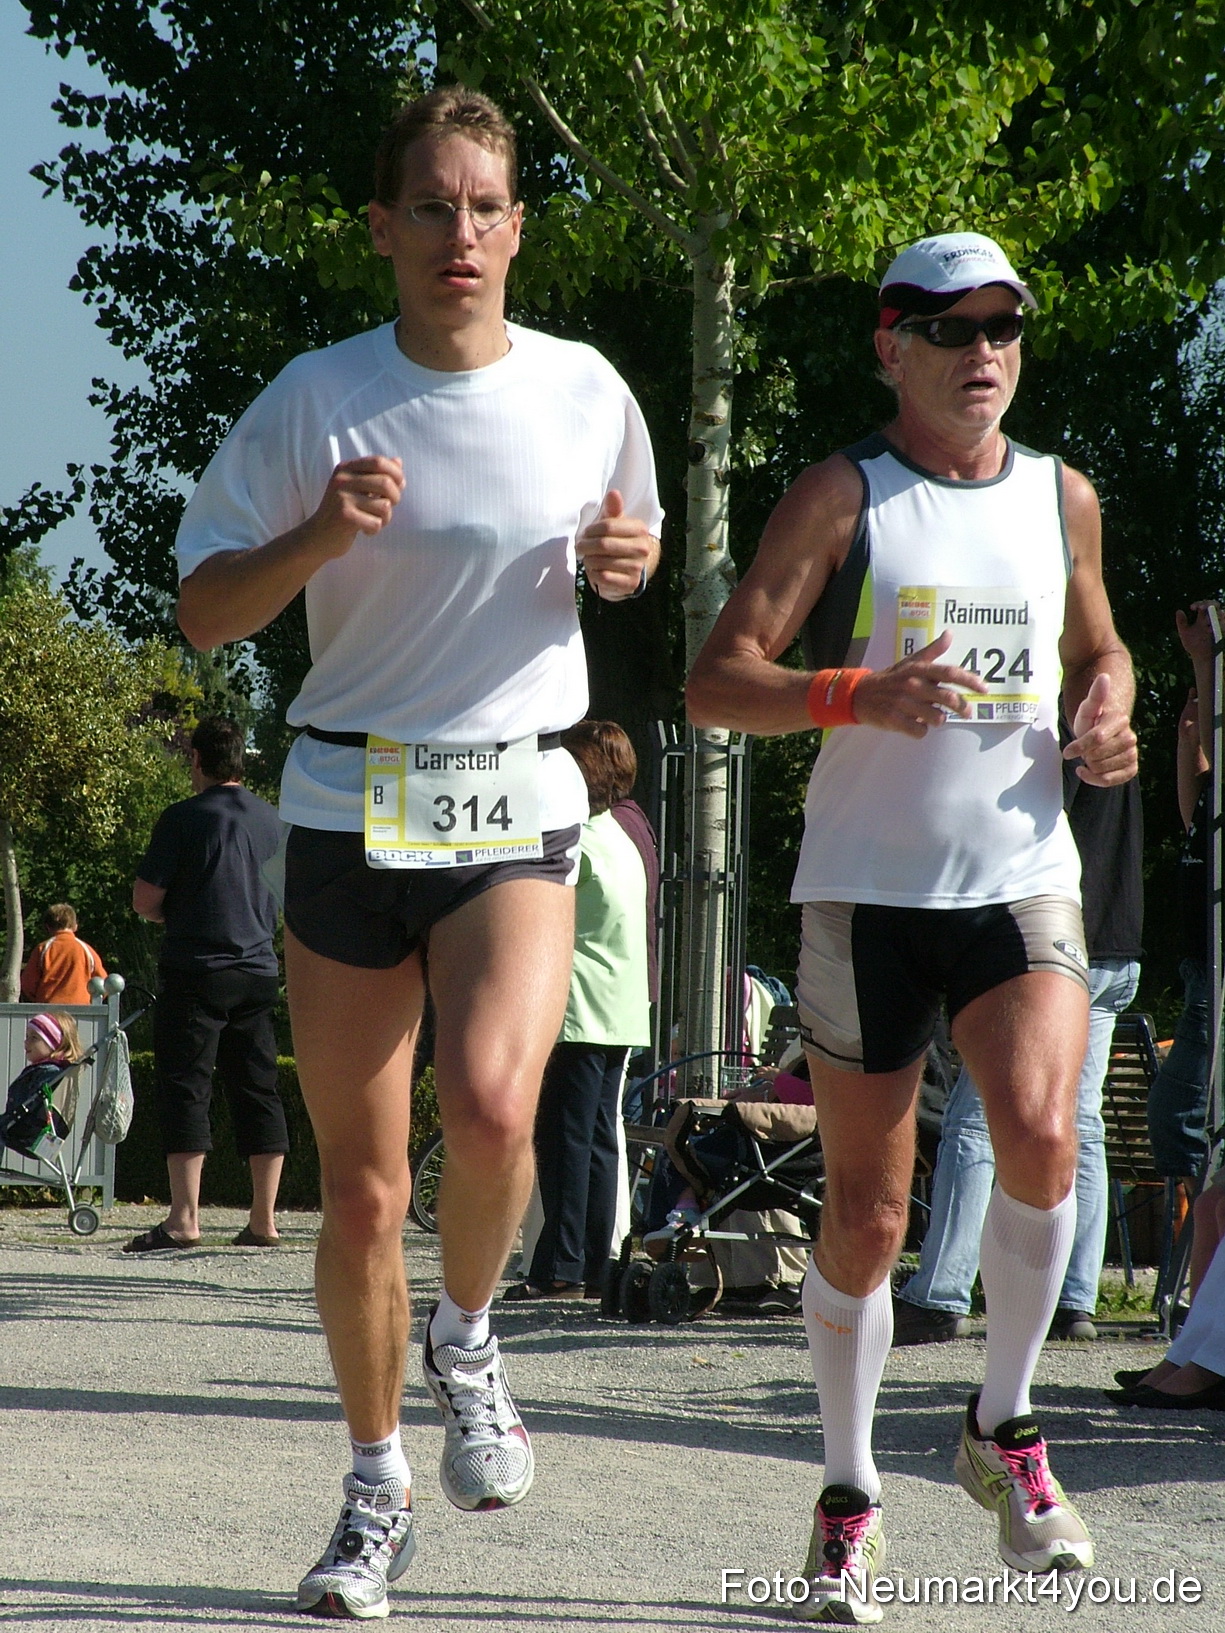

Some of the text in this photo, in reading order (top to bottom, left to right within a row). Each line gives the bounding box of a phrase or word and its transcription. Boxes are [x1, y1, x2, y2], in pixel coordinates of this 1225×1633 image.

[943, 599, 1029, 625] Raimund
[904, 638, 914, 656] B
[960, 648, 1033, 683] 424
[415, 744, 499, 771] Carsten
[373, 785, 384, 805] B
[432, 795, 513, 832] 314
[368, 849, 433, 862] BOCK
[475, 844, 539, 857] PFLEIDERER
